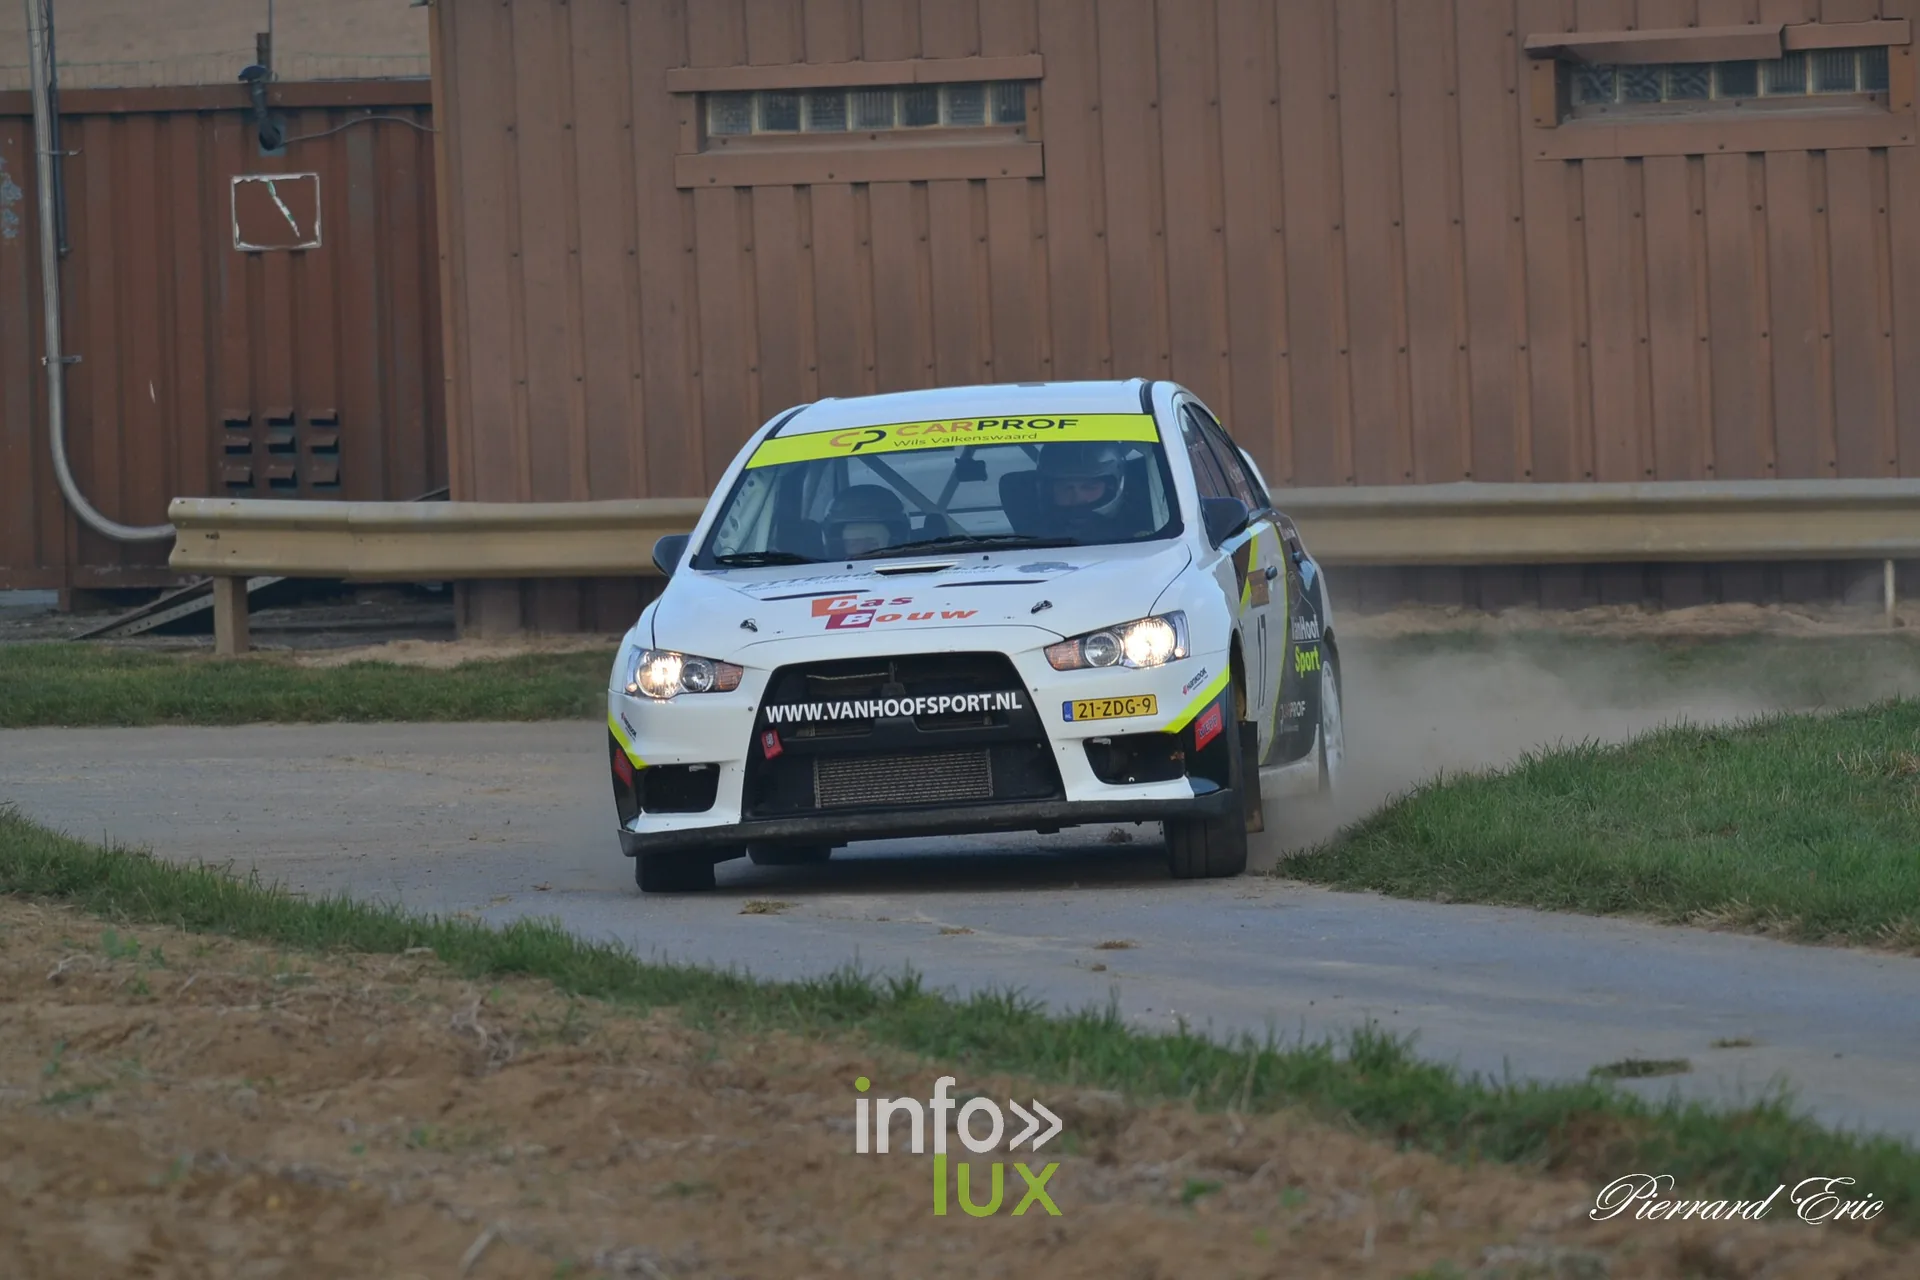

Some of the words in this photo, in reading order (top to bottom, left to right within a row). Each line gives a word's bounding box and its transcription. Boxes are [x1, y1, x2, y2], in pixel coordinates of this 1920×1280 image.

[896, 418, 1079, 437] CARPROF
[893, 438, 927, 448] Wils
[931, 432, 1038, 445] Valkenswaard
[838, 610, 978, 627] Bouw
[1294, 645, 1320, 679] Sport
[765, 692, 1023, 723] WWW.VANHOOFSPORT.NL
[1078, 697, 1151, 718] 21-ZDG-9
